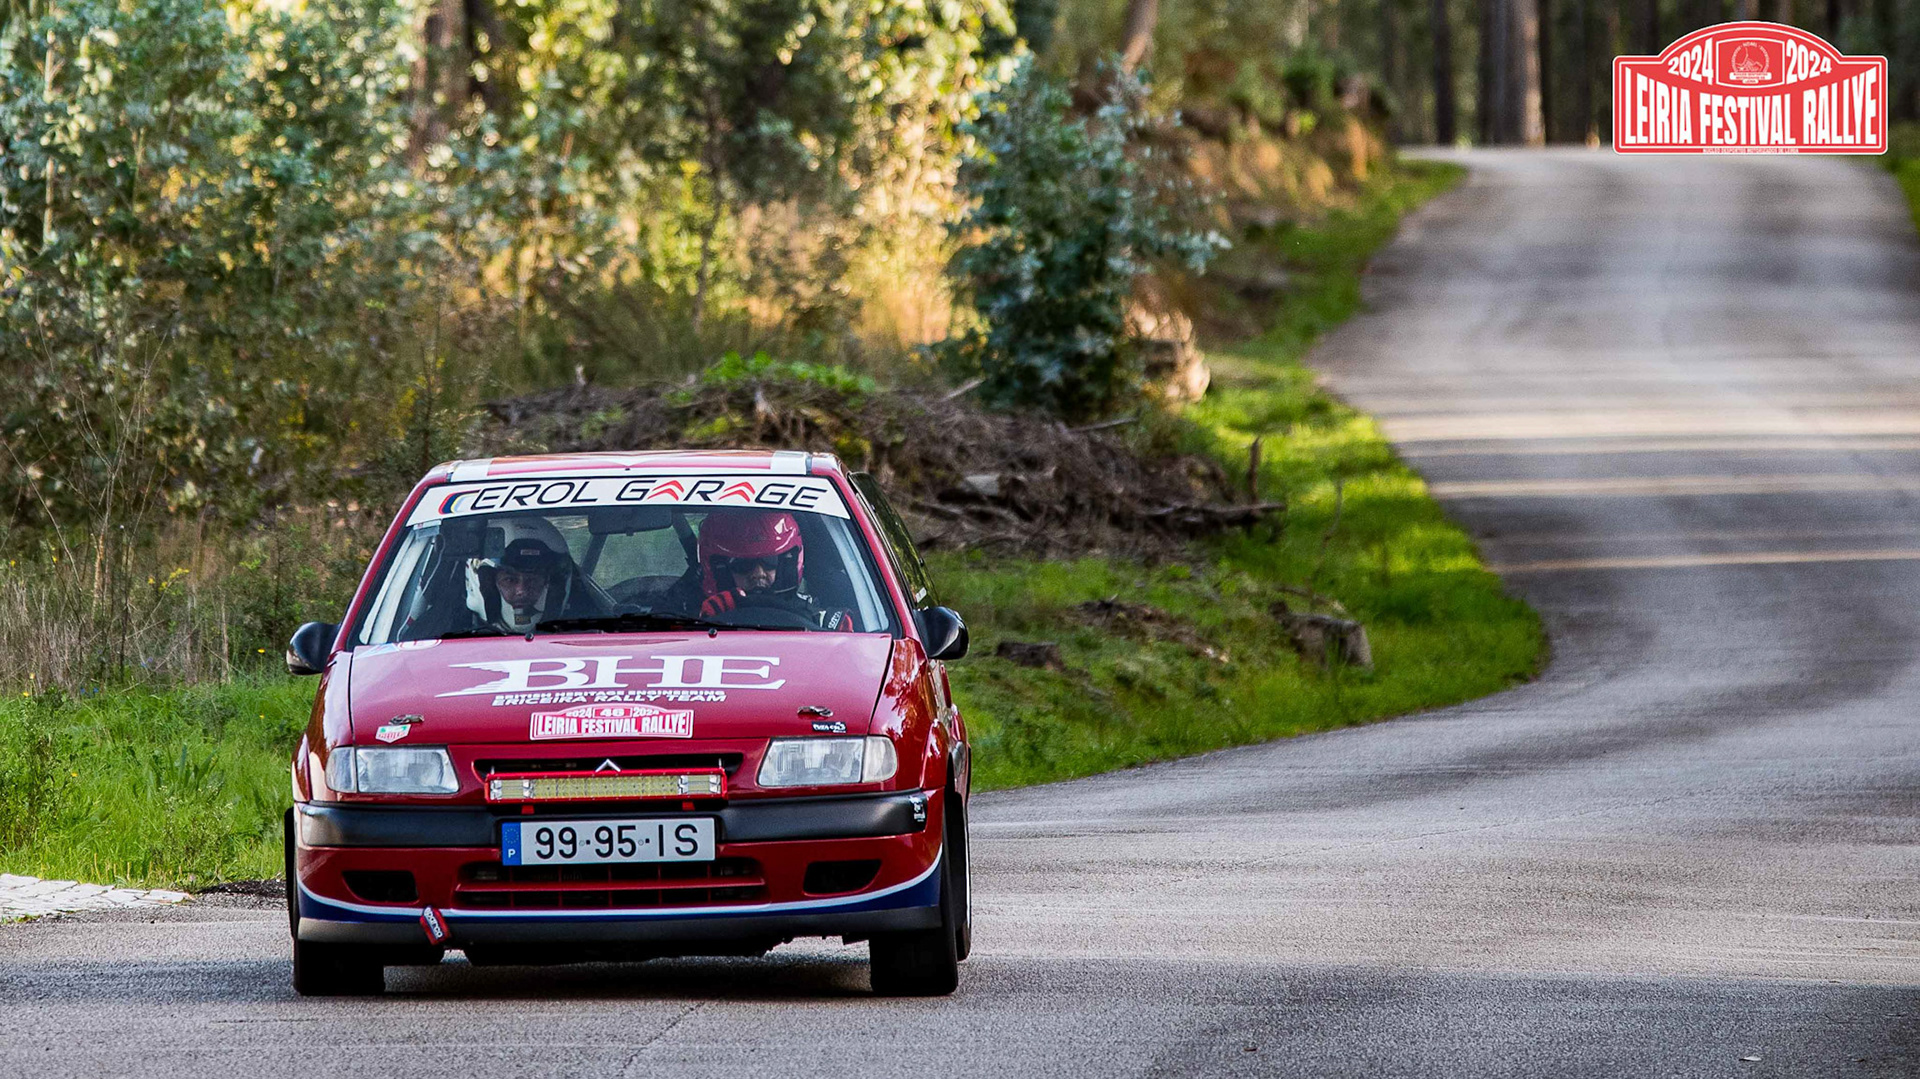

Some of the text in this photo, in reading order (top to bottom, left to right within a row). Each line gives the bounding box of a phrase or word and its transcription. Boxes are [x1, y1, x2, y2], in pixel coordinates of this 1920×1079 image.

[616, 480, 828, 509] GARAGE
[496, 655, 787, 690] BHE
[593, 693, 661, 703] RALLY
[666, 693, 727, 702] TEAM
[565, 707, 592, 719] 2024
[633, 707, 660, 718] 2024
[537, 712, 687, 735] LEIRIA FESTIVAL RALLYE
[507, 848, 516, 859] P
